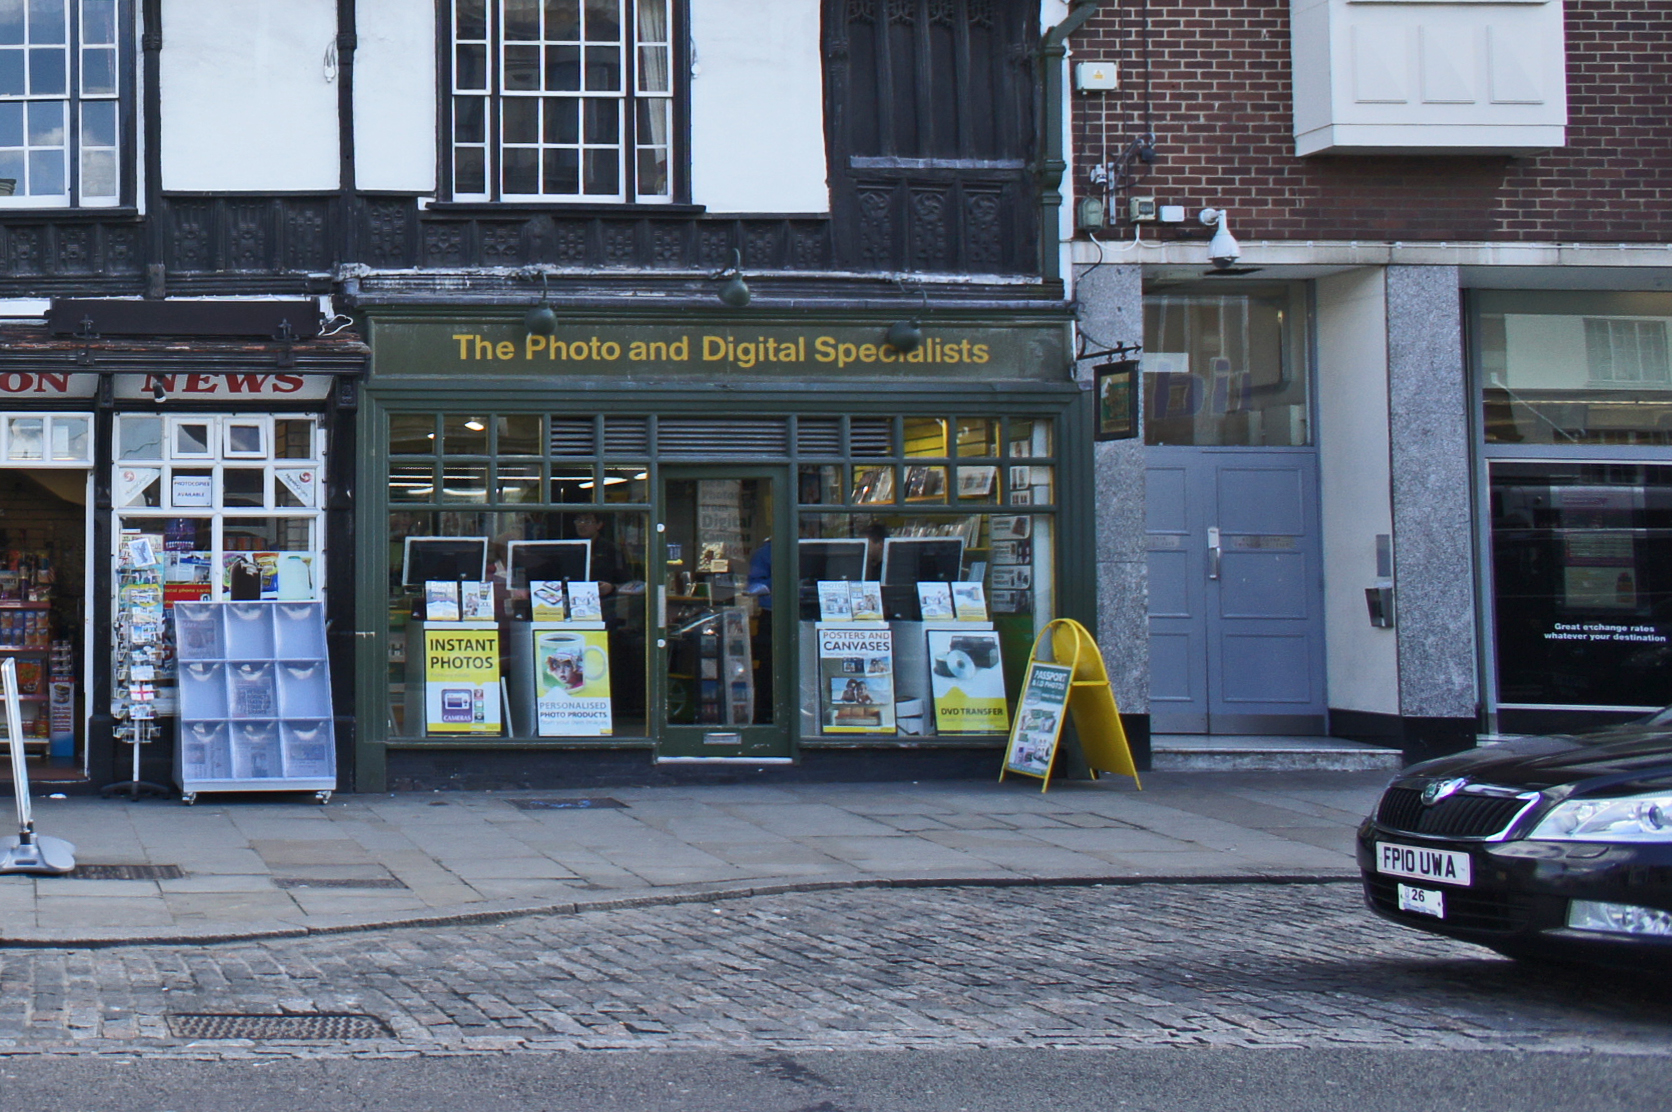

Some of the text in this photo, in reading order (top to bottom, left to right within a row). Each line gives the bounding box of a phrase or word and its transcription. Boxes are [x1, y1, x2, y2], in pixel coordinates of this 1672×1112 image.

[452, 334, 515, 361] The
[526, 334, 621, 362] Photo
[629, 335, 689, 362] and
[703, 334, 805, 368] Digital
[140, 371, 305, 395] NEWS
[1554, 623, 1580, 631] Great
[1583, 624, 1627, 632] exchange
[823, 631, 890, 640] POSTERS AND
[1544, 632, 1666, 642] whatever your destination
[430, 638, 495, 651] INSTANT
[823, 641, 890, 651] CANVASES
[430, 656, 493, 669] PHOTOS
[1033, 670, 1068, 682] PASSPORT
[540, 701, 607, 710] PERSONALISED
[540, 711, 608, 719] PHOTO PRODUCTS
[941, 707, 1004, 716] DVD TRANSFER
[443, 714, 472, 722] CAMERAS
[1383, 846, 1456, 878] FP10 UWA
[1411, 888, 1425, 902] 26
